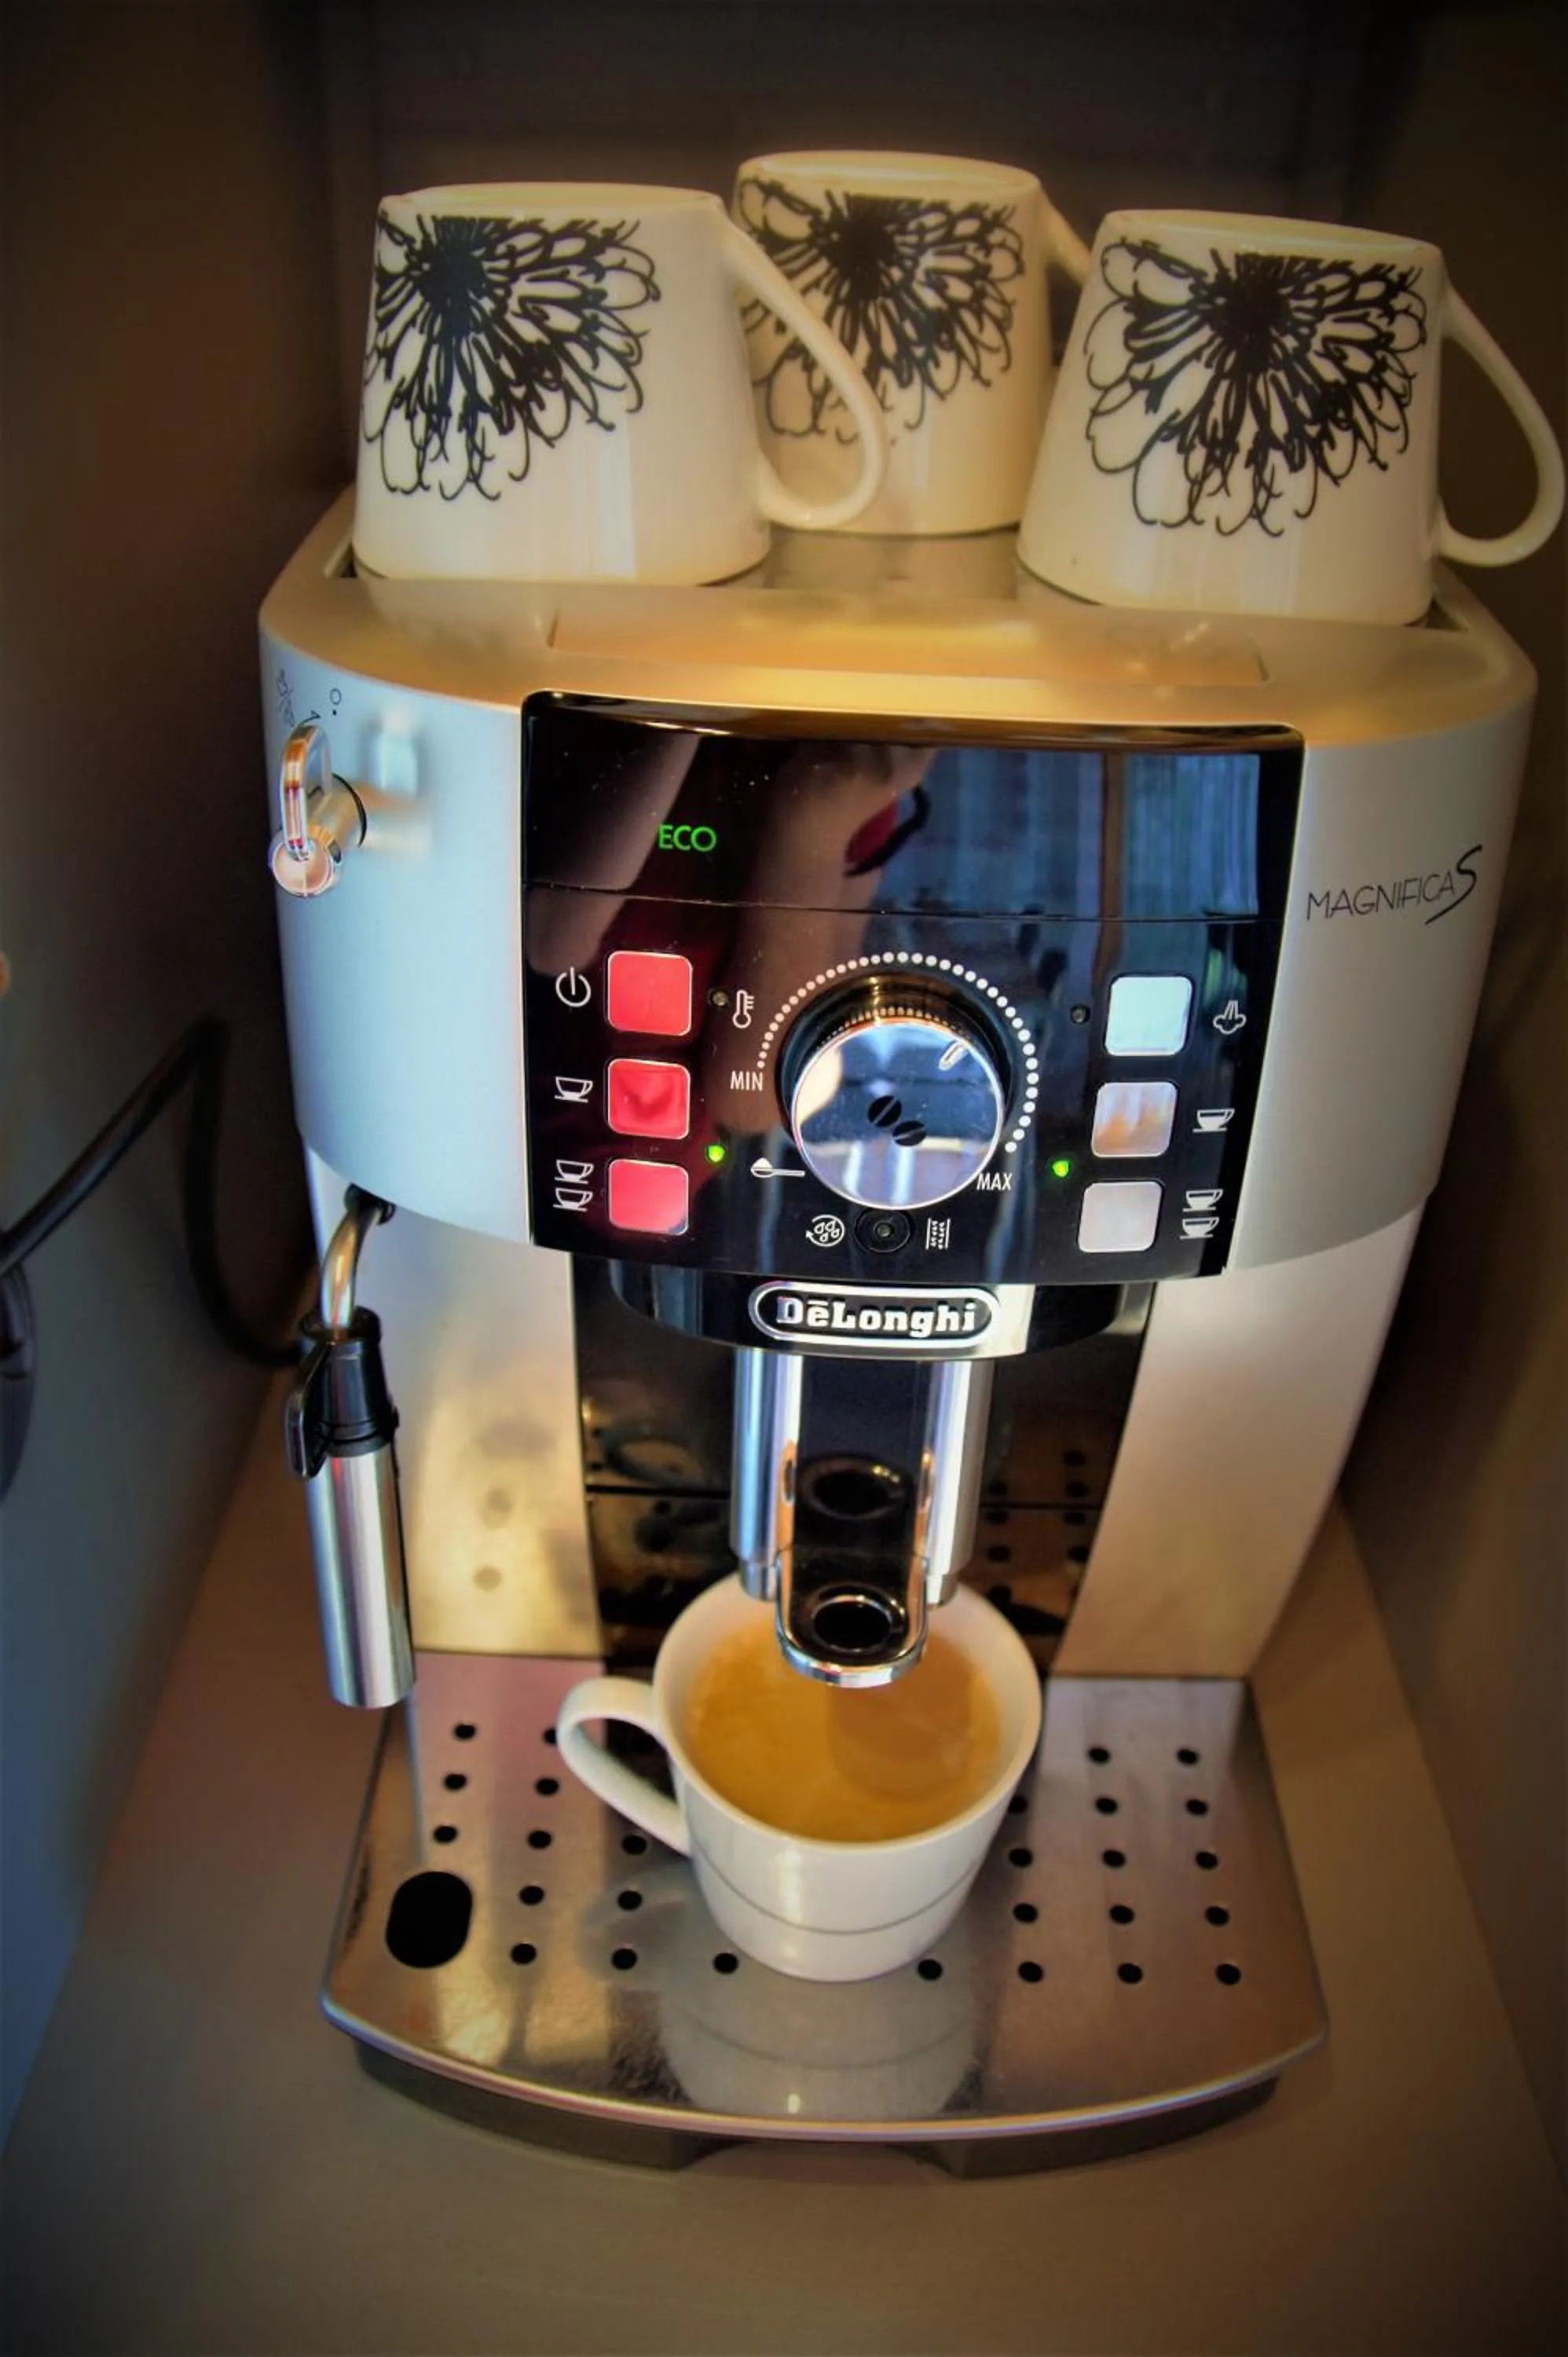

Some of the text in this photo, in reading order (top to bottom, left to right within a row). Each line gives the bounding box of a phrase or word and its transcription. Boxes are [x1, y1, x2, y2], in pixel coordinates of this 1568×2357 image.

[658, 825, 716, 852] ECO
[1306, 870, 1456, 921] MAGNIFICA
[730, 1071, 763, 1091] MIN
[976, 1172, 1013, 1191] MAX
